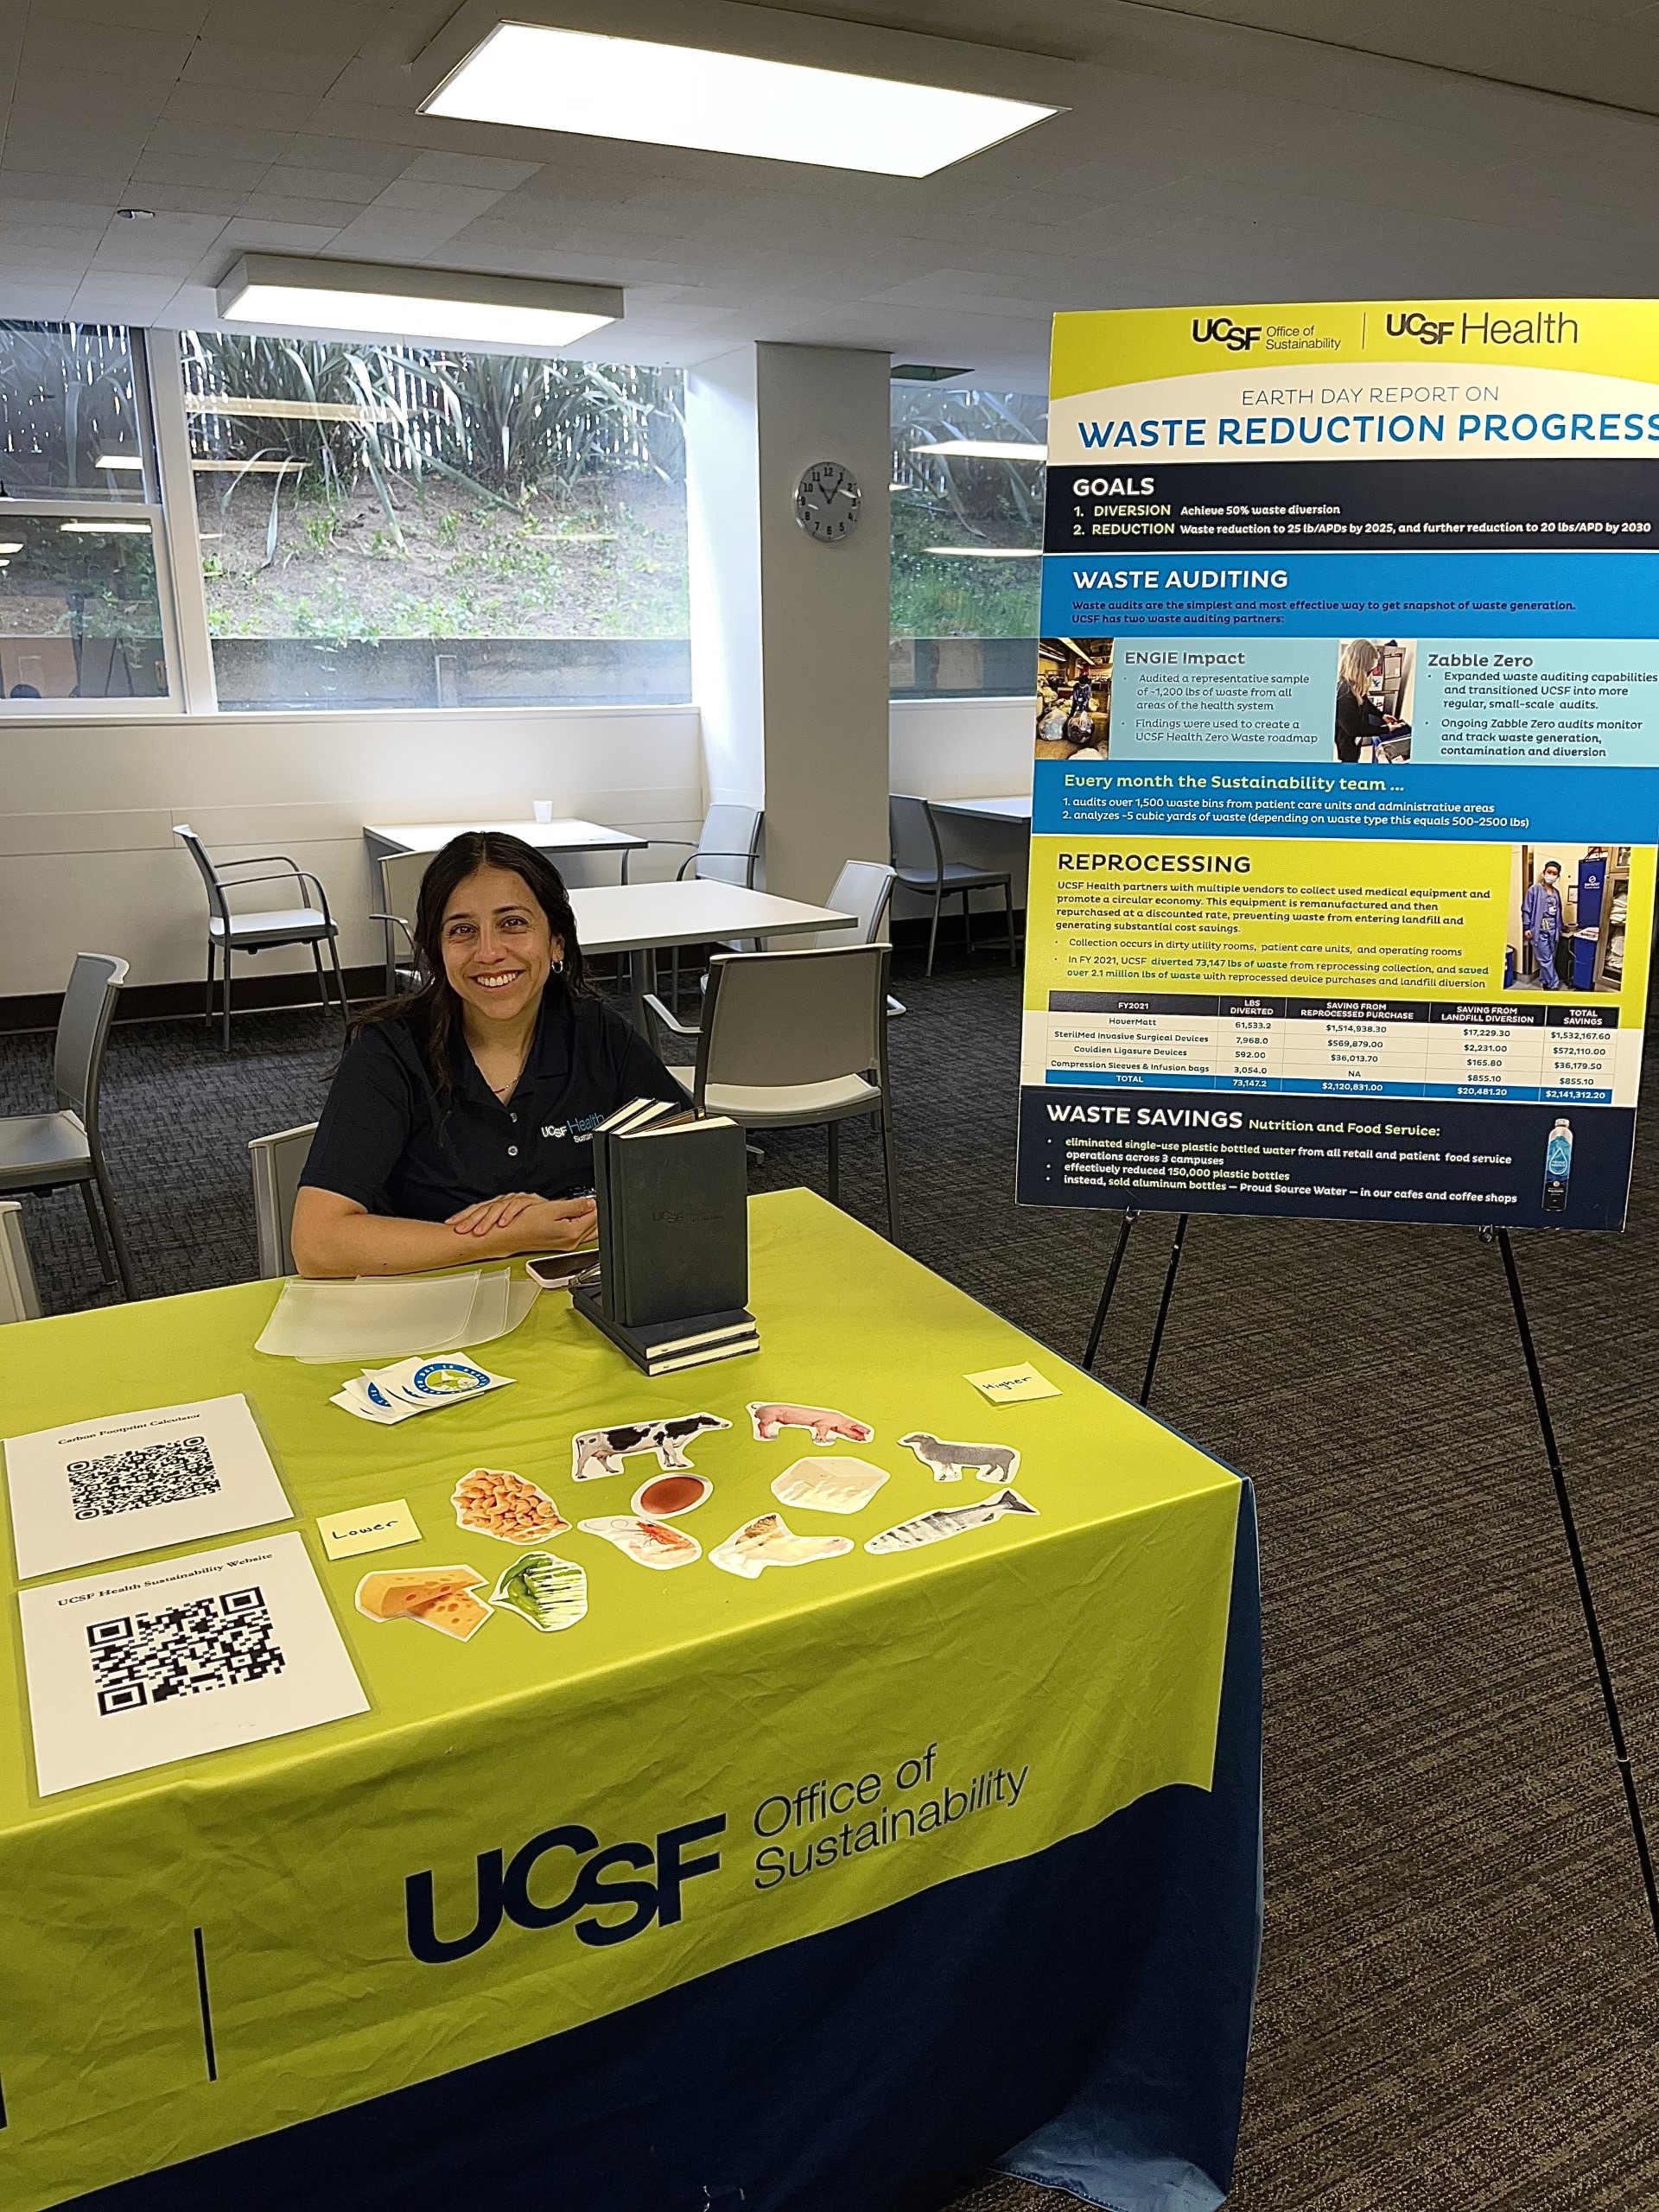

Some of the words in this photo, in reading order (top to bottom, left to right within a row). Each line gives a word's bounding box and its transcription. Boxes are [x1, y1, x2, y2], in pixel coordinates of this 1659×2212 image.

[1192, 318, 1262, 351] UCSF
[1267, 326, 1300, 337] Office
[1303, 325, 1315, 336] of
[1386, 313, 1455, 345] UCSF
[1462, 312, 1578, 344] Health
[1266, 338, 1341, 351] Sustainability
[1243, 389, 1313, 405] EARTH
[1321, 388, 1363, 404] DAY
[1370, 386, 1459, 403] REPORT
[1465, 386, 1498, 401] ON
[1077, 419, 1205, 448] WASTE
[1218, 415, 1444, 444] REDUCTION
[812, 472, 821, 481] 11
[824, 467, 834, 477] 12
[804, 483, 813, 492] 10
[1072, 477, 1154, 496] GOALS
[1073, 505, 1084, 517] 1.
[1094, 505, 1171, 516] DIVERSION
[1180, 505, 1224, 515] Achieve
[1225, 505, 1249, 515] 50%
[1250, 505, 1286, 515] waste
[1287, 504, 1340, 514] diversion
[1073, 524, 1084, 535] 2.
[1092, 523, 1174, 535] REDUCTION
[1179, 524, 1214, 534] Waste
[1216, 524, 1271, 533] reduction
[1273, 524, 1285, 533] to
[1287, 524, 1300, 533] 25
[1303, 524, 1347, 533] lb/APDs
[1349, 523, 1363, 535] by
[1364, 523, 1395, 534] 2025,
[1398, 523, 1421, 532] and
[1422, 522, 1465, 532] further
[1466, 522, 1523, 532] reduction
[1525, 523, 1538, 531] to
[1540, 522, 1555, 531] 20
[1557, 522, 1603, 531] lbs/APD
[1605, 522, 1619, 534] by
[1621, 522, 1650, 532] 2030
[1072, 570, 1159, 588] WASTE
[1164, 570, 1287, 588] AUDITING
[1071, 614, 1100, 623] UCSF
[1102, 614, 1121, 623] has
[1123, 614, 1145, 623] two
[1183, 613, 1230, 625] auditing
[1232, 615, 1284, 624] partners:
[1125, 652, 1178, 664] ENGIE
[1183, 652, 1245, 666] Impact
[1427, 653, 1488, 666] Zabble
[1493, 654, 1533, 667] Zero
[1139, 673, 1179, 683] Audited
[1191, 674, 1268, 684] representative
[1270, 675, 1309, 684] sample
[1444, 671, 1500, 682] Expanded
[1503, 672, 1537, 681] waste
[1540, 671, 1588, 683] auditing
[1591, 672, 1657, 683] capabilities
[1444, 685, 1465, 694] and
[1468, 685, 1538, 695] transitioned
[1541, 685, 1571, 695] UCSF
[1573, 685, 1596, 695] into
[1065, 774, 1113, 789] Every
[1116, 775, 1173, 787] month
[1178, 775, 1206, 787] the
[1211, 776, 1335, 792] Sustainability
[1338, 778, 1386, 790] team
[1058, 854, 1249, 873] REPROCESSING
[1055, 921, 1111, 931] generating
[1113, 922, 1172, 931] substantial
[1198, 924, 1241, 934] savings.
[1365, 1011, 1414, 1020] PURCHASE
[1485, 1014, 1534, 1023] DIVERSION
[1325, 1024, 1386, 1033] $1,514,938.30
[1463, 1028, 1510, 1037] $17,229.30
[1136, 1033, 1173, 1042] Surgical
[1327, 1039, 1382, 1048] $569,879.00
[1114, 1046, 1151, 1055] Ligasure
[1553, 1046, 1605, 1055] $572,110.00
[1554, 1061, 1601, 1070] $36,179.50
[1322, 1082, 1382, 1091] $2,120,831.00
[1457, 1087, 1507, 1096] $20,481.20
[1545, 1090, 1605, 1099] $2,141,312.20
[541, 1125, 567, 1137] UCSF
[567, 1113, 604, 1134] Health
[1046, 1104, 1130, 1123] WASTE
[1137, 1109, 1243, 1128] SAVINGS
[1249, 1119, 1313, 1131] Nutrition
[1316, 1122, 1344, 1132] and
[1347, 1122, 1382, 1134] Food
[1384, 1124, 1440, 1136] Service:
[1064, 1162, 1120, 1174] effectively
[1122, 1166, 1166, 1175] reduced
[1167, 1167, 1210, 1177] 150,000
[1212, 1169, 1249, 1179] plastic
[1251, 1171, 1289, 1180] bottles
[982, 1376, 1032, 1390] Higher
[58, 1433, 96, 1444] Carbon
[99, 1423, 146, 1435] Footprint
[149, 1414, 200, 1426] Calculator
[332, 1521, 398, 1539] Lower
[58, 1592, 94, 1605] UCSF
[99, 1584, 140, 1597] Health
[143, 1566, 223, 1586] Sustainability
[226, 1554, 272, 1567] Website
[753, 1773, 881, 1837] Office
[897, 1743, 938, 1789] of
[754, 1766, 1029, 1889] Sustainability
[405, 1813, 727, 1964] UCSF
